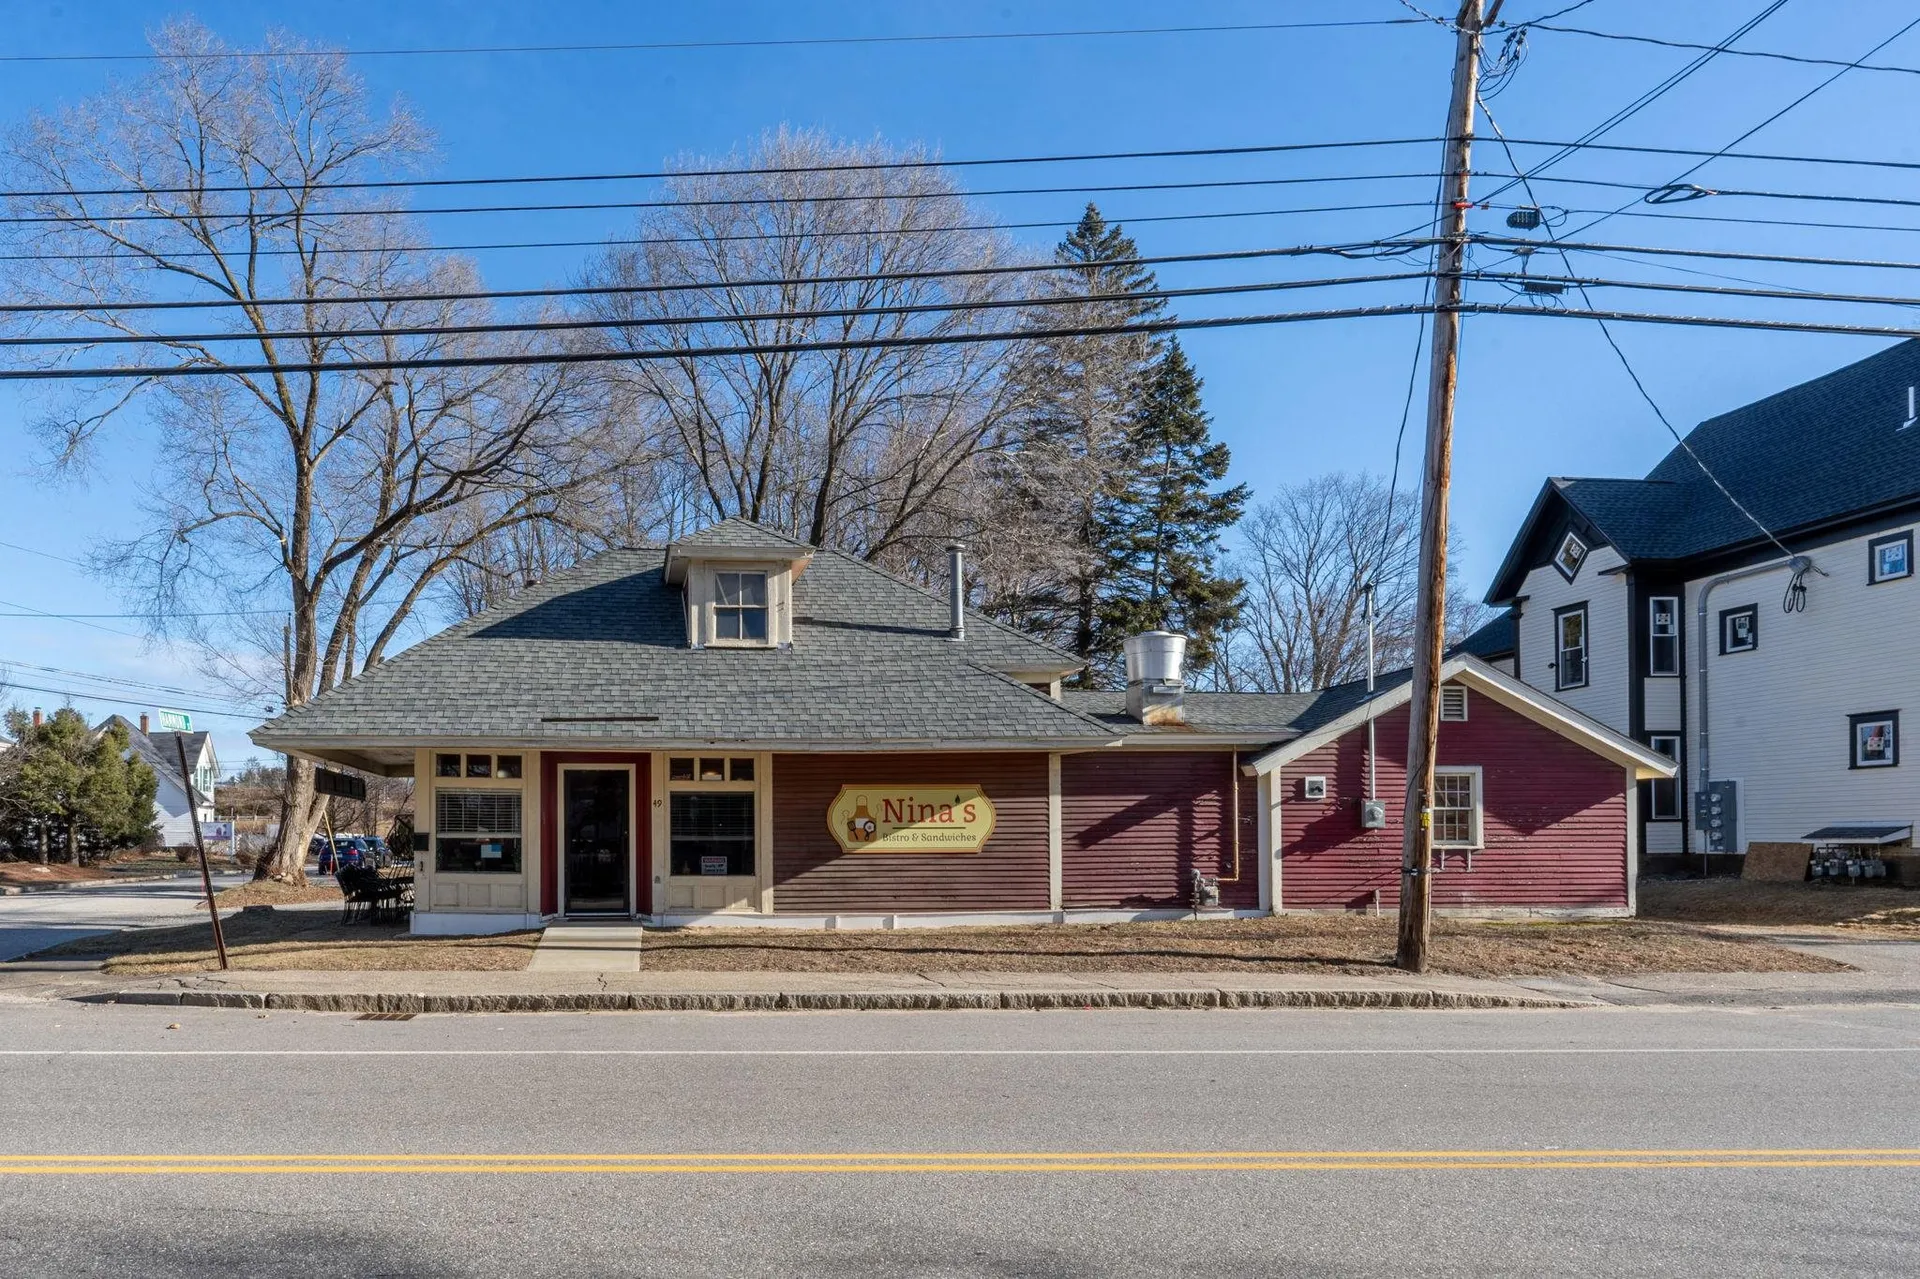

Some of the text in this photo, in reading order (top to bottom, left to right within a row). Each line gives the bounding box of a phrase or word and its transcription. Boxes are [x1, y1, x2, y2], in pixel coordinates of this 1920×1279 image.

[882, 795, 977, 823] Nina's
[882, 833, 976, 842] Bistro & Sandwiches
